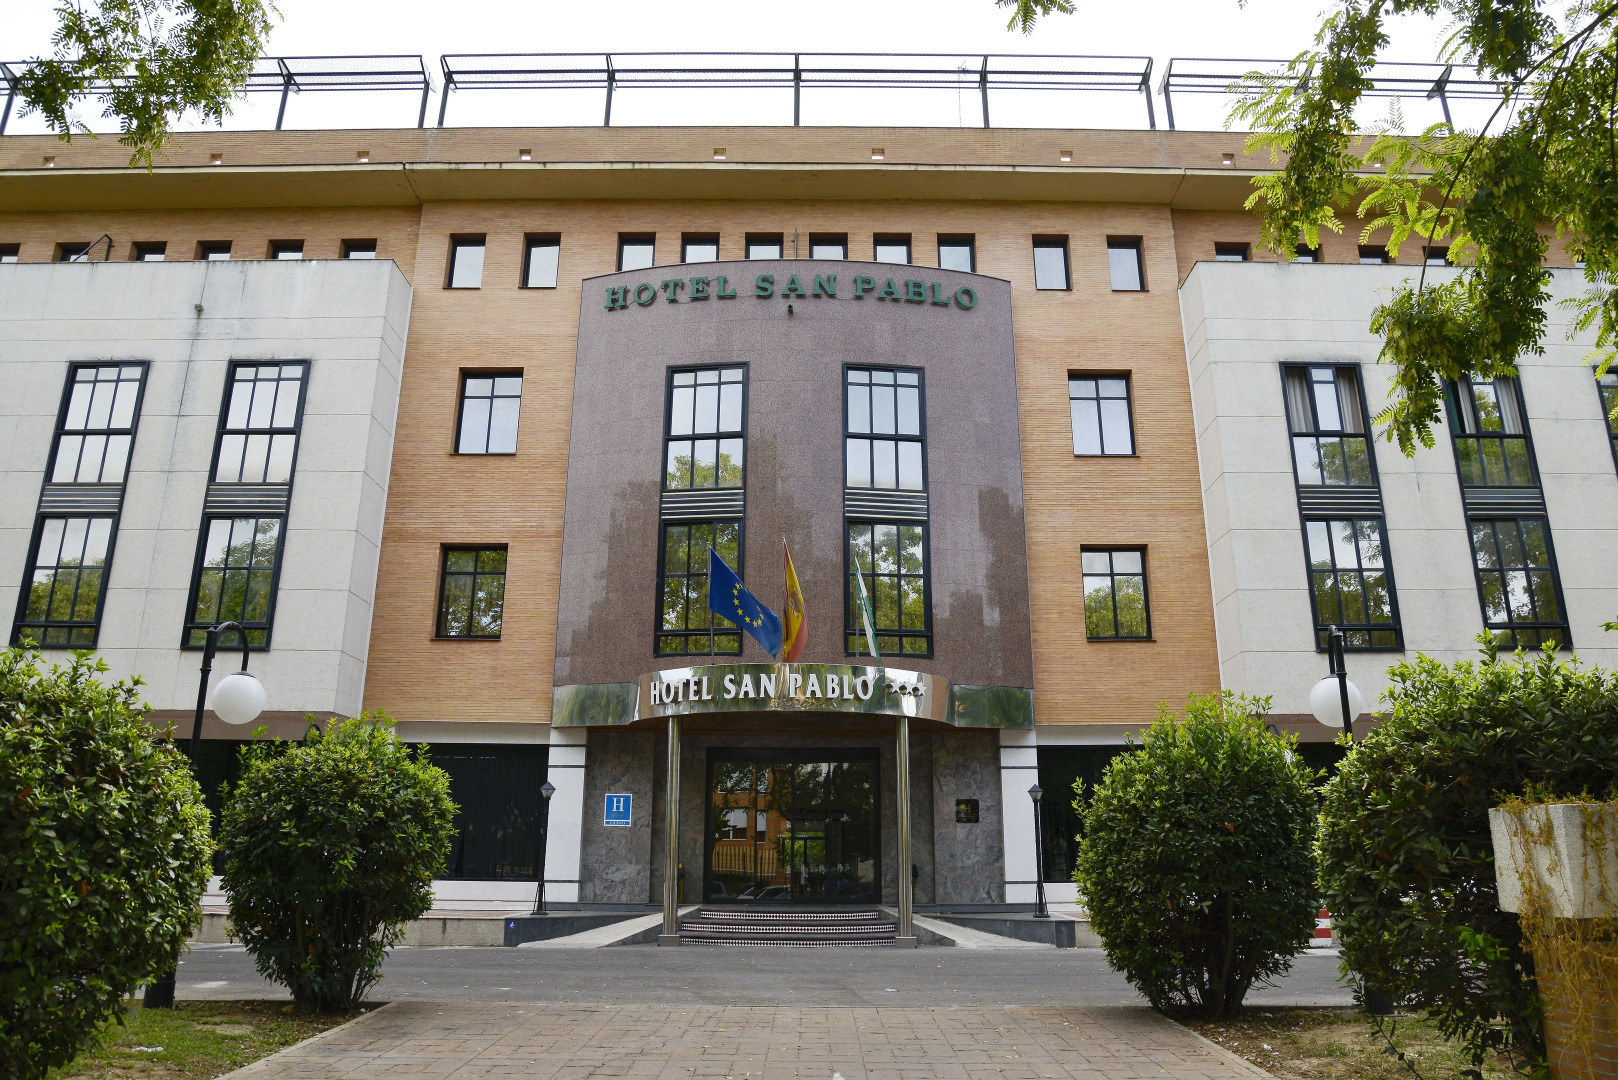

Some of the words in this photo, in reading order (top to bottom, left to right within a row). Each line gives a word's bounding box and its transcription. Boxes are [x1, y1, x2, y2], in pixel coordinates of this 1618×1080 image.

[604, 276, 737, 309] HOTEL
[755, 274, 838, 297] SAN
[853, 275, 979, 309] PABLO
[649, 676, 713, 704] HOTEL
[723, 673, 776, 698] SAN
[789, 673, 874, 699] PABLO
[611, 797, 626, 812] H
